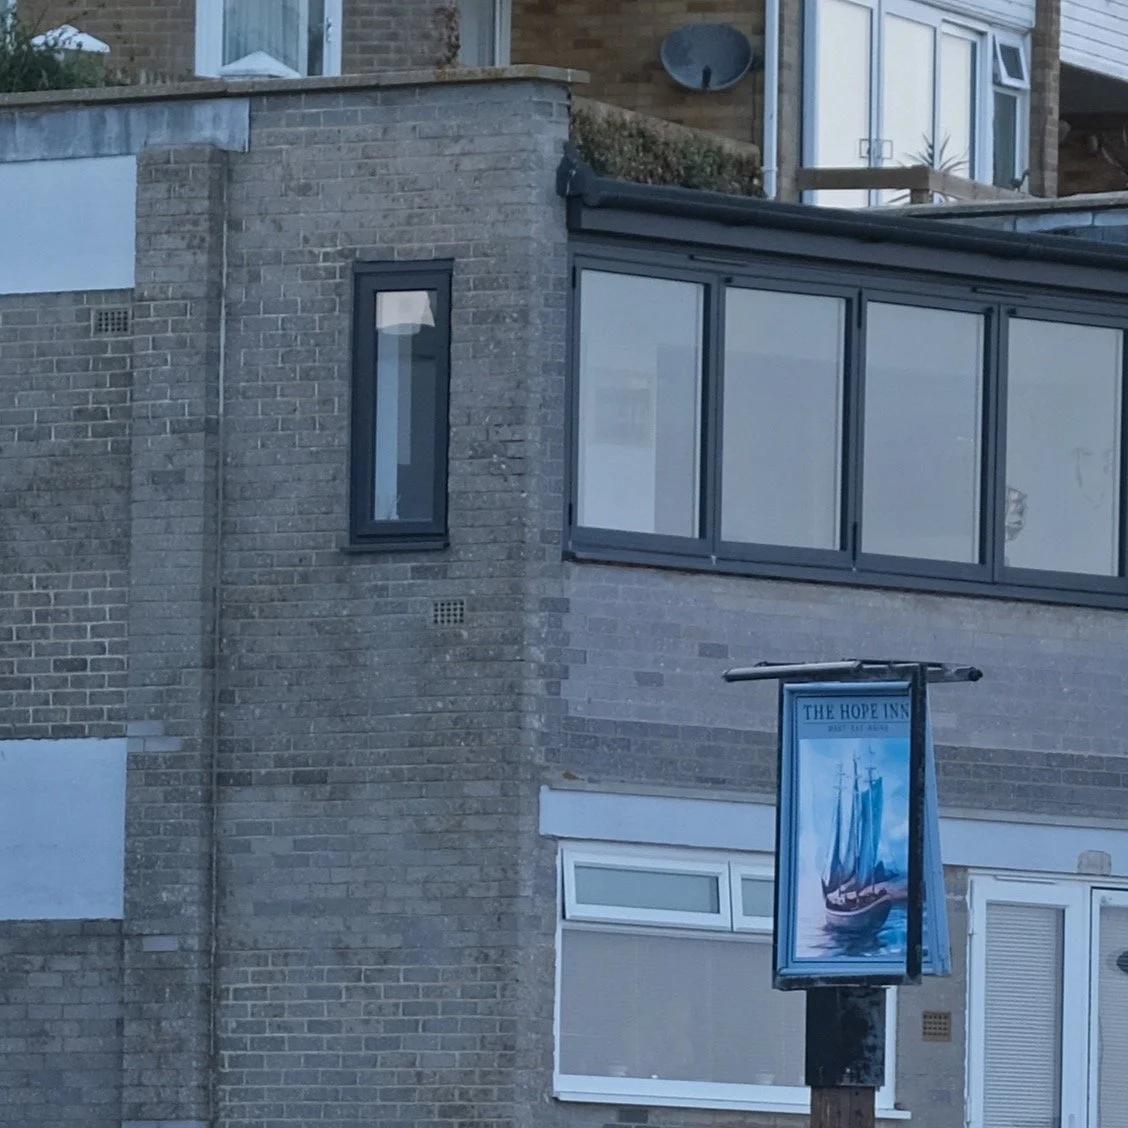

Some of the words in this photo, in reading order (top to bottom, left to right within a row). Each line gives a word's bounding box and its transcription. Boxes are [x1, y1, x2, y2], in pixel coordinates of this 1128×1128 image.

[803, 703, 834, 720] THE
[840, 702, 878, 720] HOPE
[884, 702, 910, 719] INN
